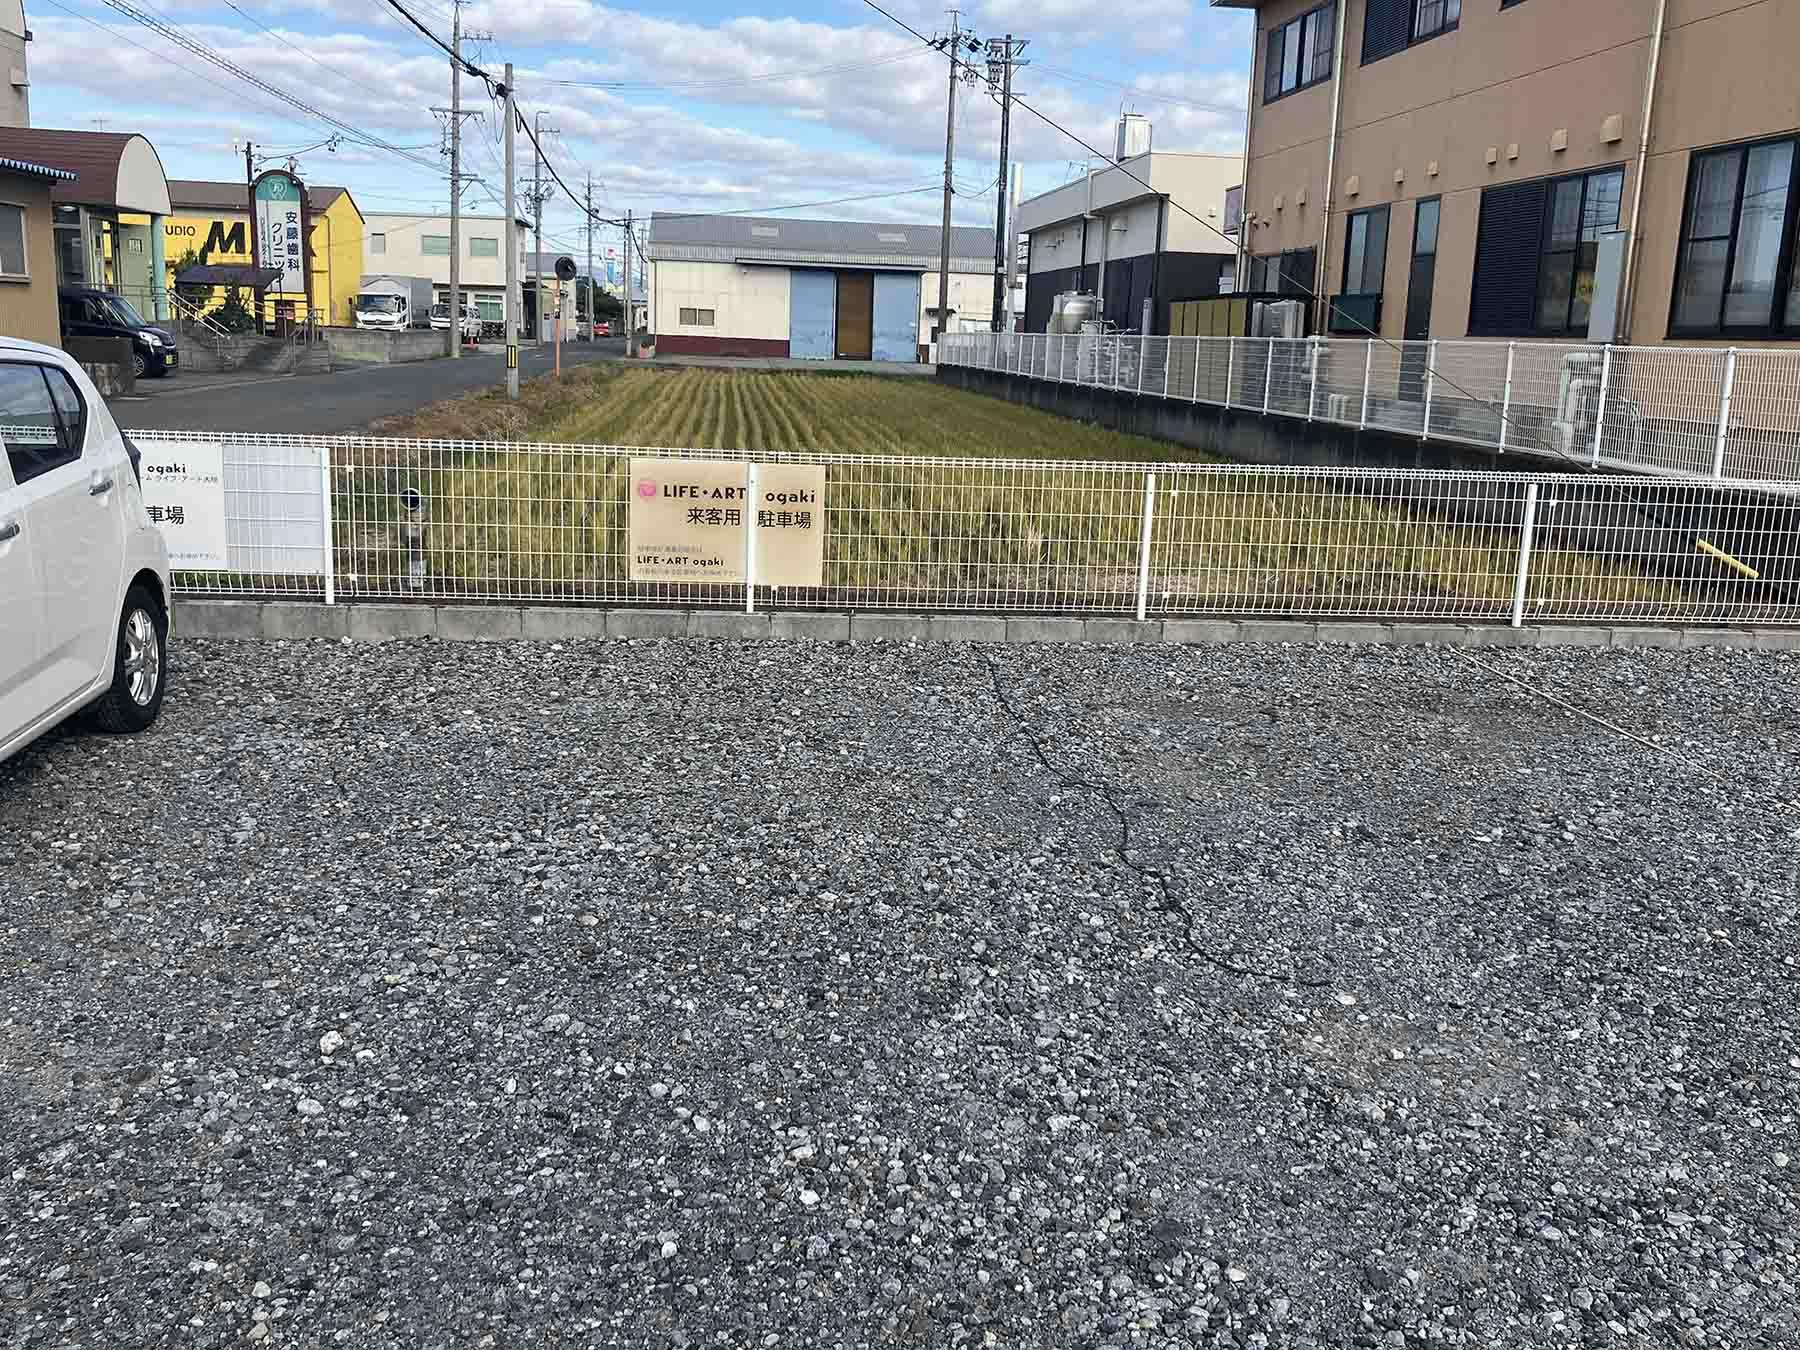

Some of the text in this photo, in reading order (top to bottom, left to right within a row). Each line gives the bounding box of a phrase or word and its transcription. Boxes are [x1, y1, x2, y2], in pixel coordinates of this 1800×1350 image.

[285, 211, 300, 271] 安藤歯科
[147, 463, 186, 476] ogaki
[765, 489, 816, 505] ogaki
[693, 556, 724, 567] ogaki
